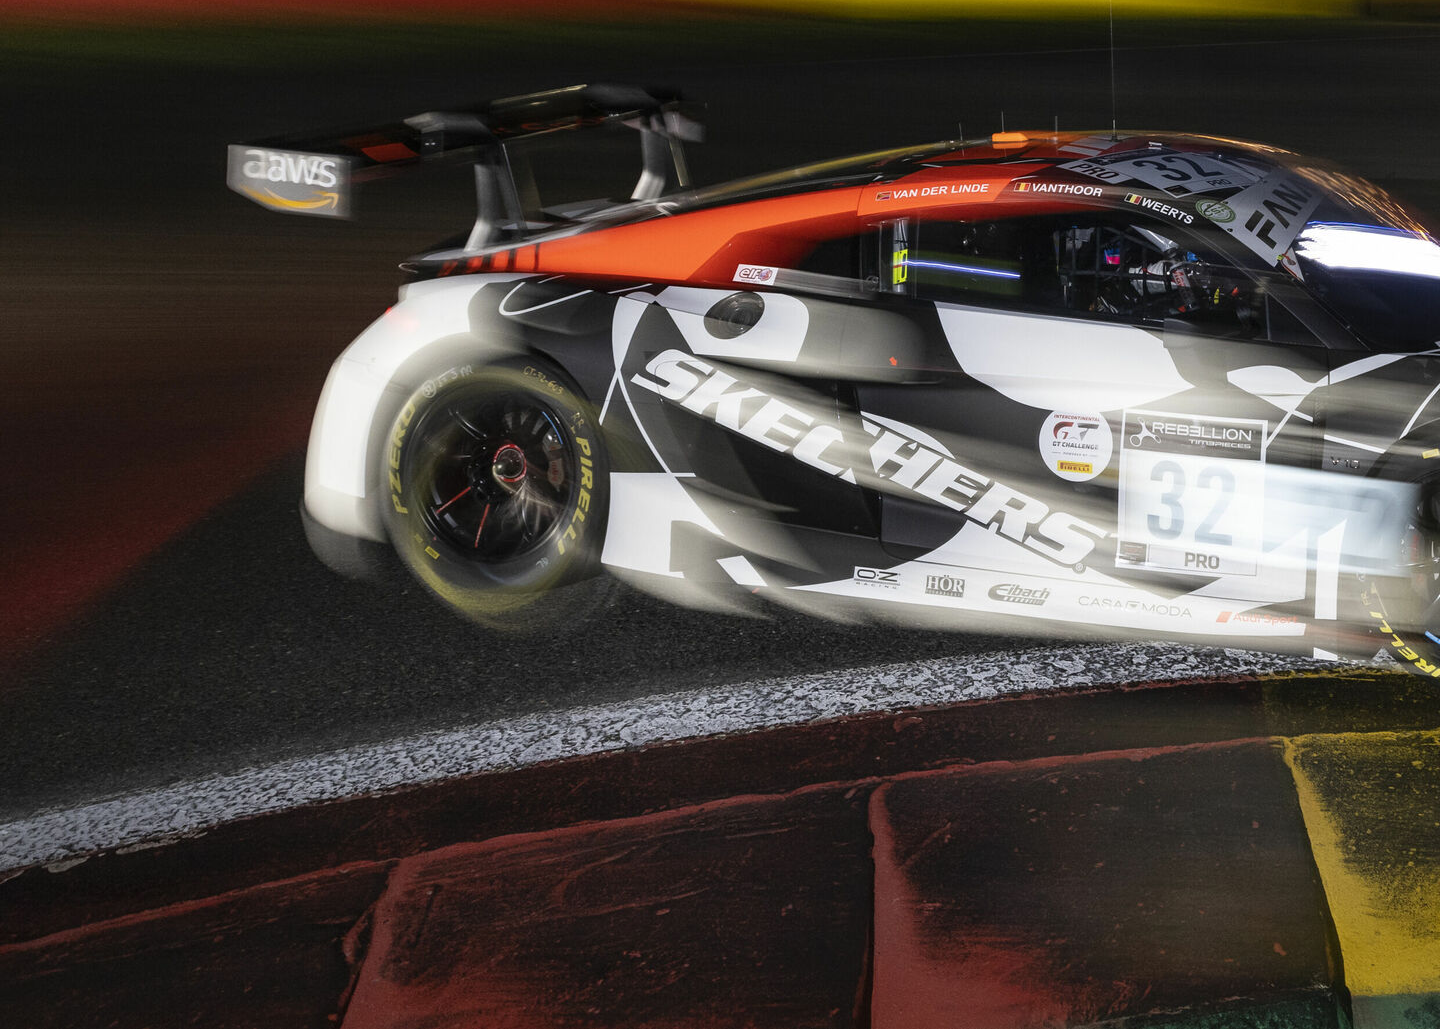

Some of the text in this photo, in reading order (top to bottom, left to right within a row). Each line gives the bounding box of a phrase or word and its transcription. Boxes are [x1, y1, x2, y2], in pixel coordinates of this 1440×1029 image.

[1070, 163, 1120, 179] PRO
[1132, 156, 1223, 181] 32
[893, 183, 989, 199] VAN DER LINDE
[1032, 183, 1103, 197] VANTHOOR
[1206, 178, 1232, 187] PRO
[1141, 198, 1194, 225] WEERTS
[1062, 441, 1099, 450] CHALLENGE
[631, 349, 1105, 565] SKECHERS
[557, 436, 593, 555] PIRELLI
[1147, 460, 1235, 546] 32
[1184, 552, 1220, 570] PRO
[927, 575, 964, 593] HÖR
[988, 583, 1050, 602] Eibach
[1078, 595, 1193, 618] CASA MODA
[1233, 613, 1298, 626] Audi Sport
